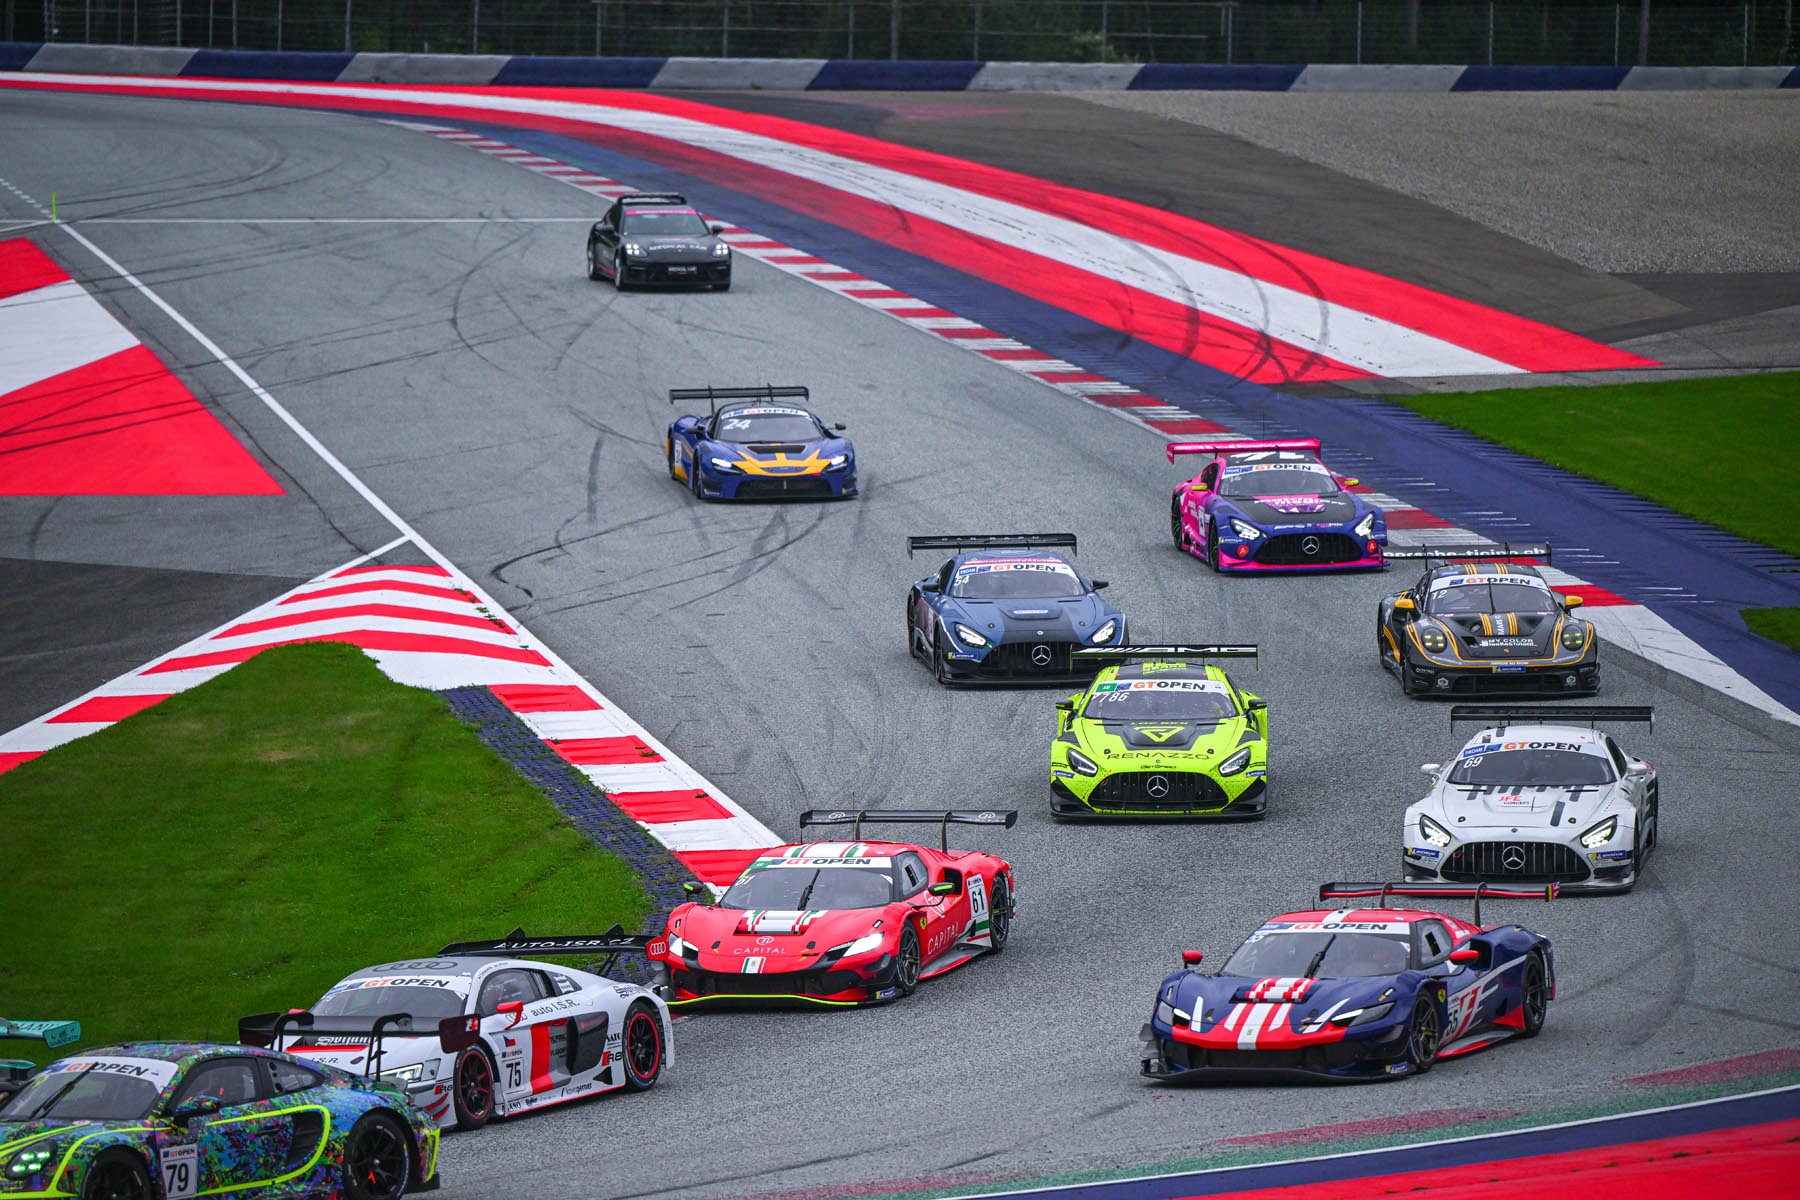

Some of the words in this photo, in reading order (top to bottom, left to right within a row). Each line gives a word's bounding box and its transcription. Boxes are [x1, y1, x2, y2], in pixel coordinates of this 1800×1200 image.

[723, 419, 751, 430] 24
[954, 575, 970, 587] 54
[1432, 589, 1448, 600] 12
[1099, 691, 1130, 703] 786
[1107, 752, 1210, 760] RENAZZO
[1463, 756, 1483, 769] 69
[971, 887, 985, 913] 61
[927, 921, 959, 955] CAPITAL
[733, 947, 787, 955] CAPITAL
[531, 1005, 554, 1017] auto
[505, 1061, 522, 1089] 75
[165, 1162, 189, 1193] 79
